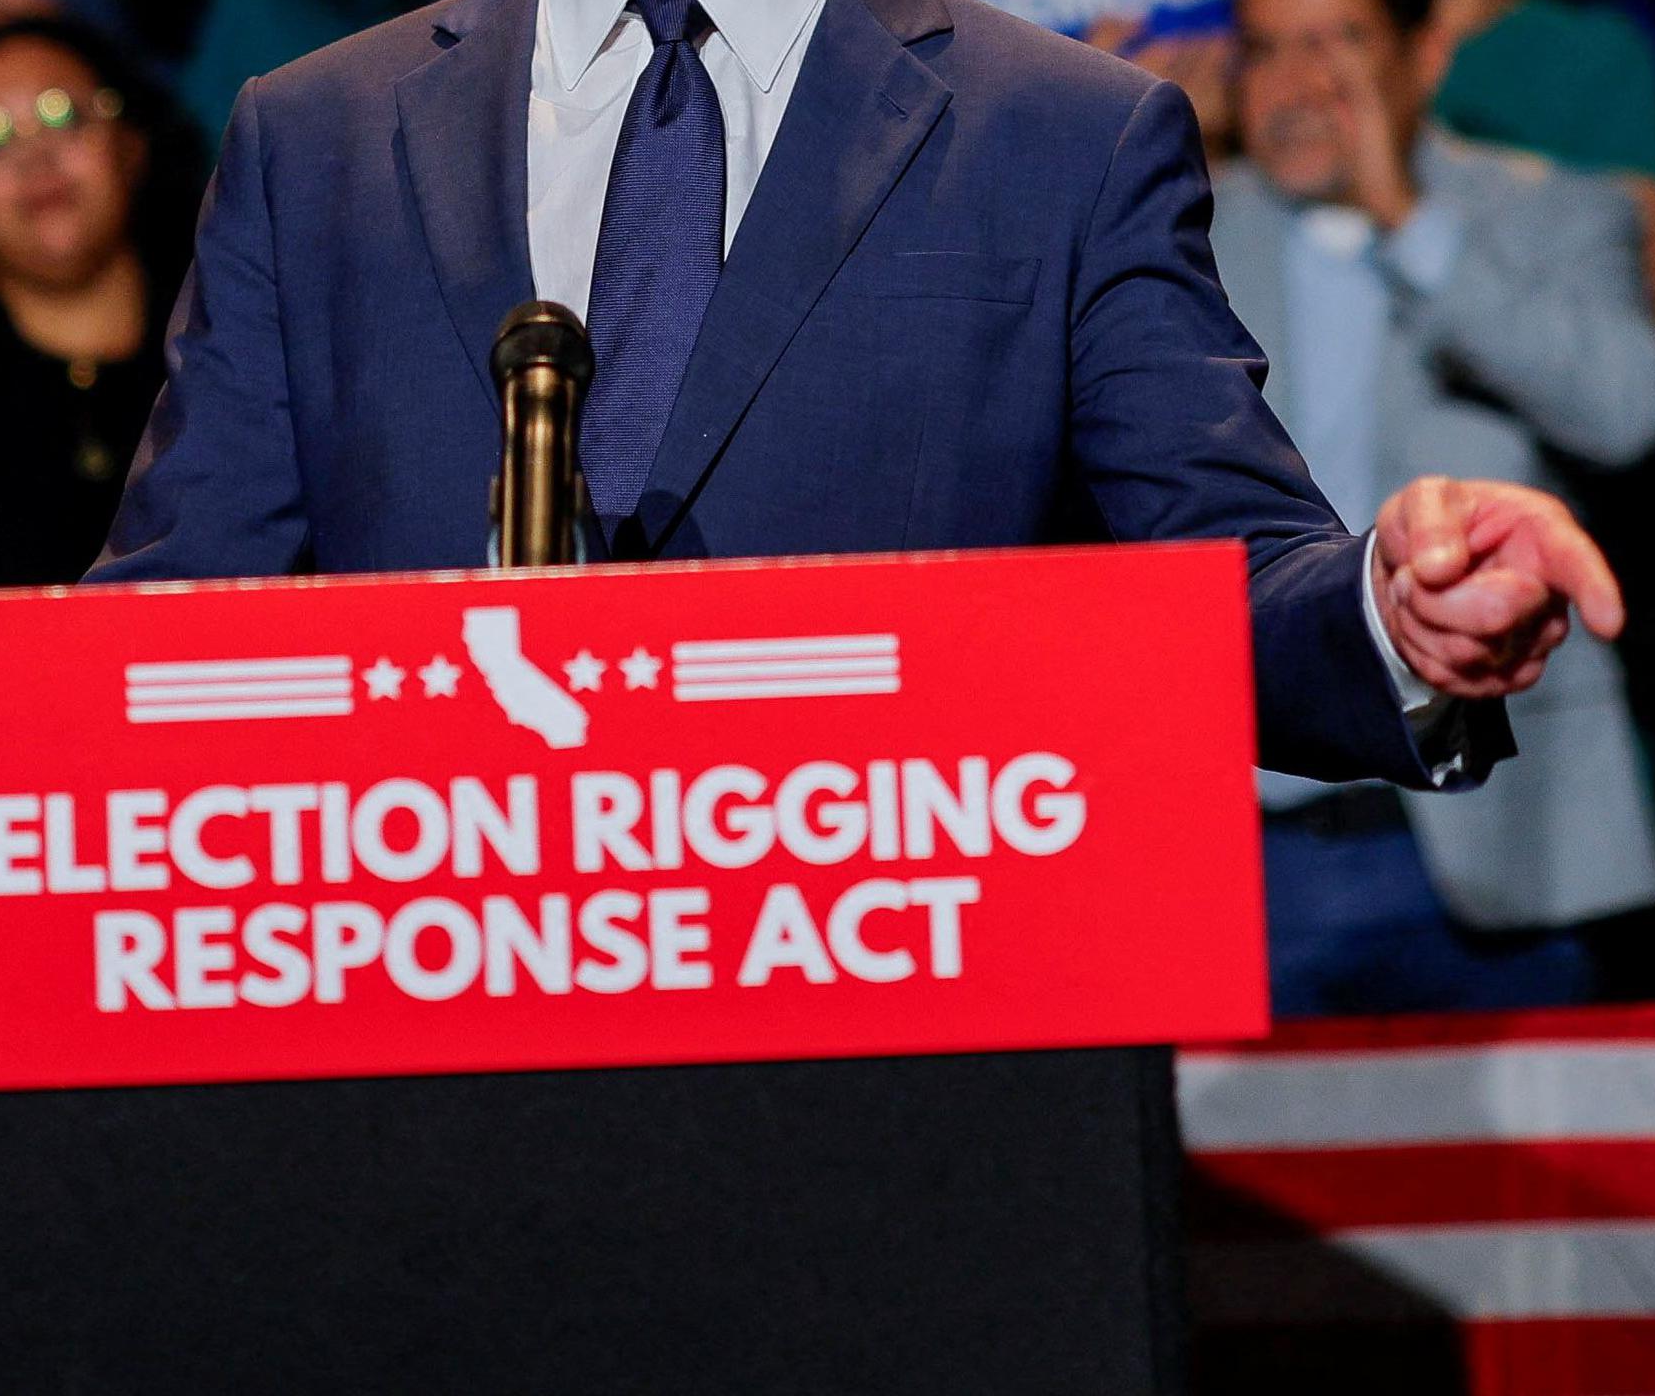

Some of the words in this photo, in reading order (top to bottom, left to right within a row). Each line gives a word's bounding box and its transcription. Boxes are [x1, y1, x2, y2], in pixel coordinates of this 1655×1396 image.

[571, 751, 1087, 874] RIGGING
[93, 885, 714, 1013] RESPONSE
[737, 875, 981, 988] ACT
